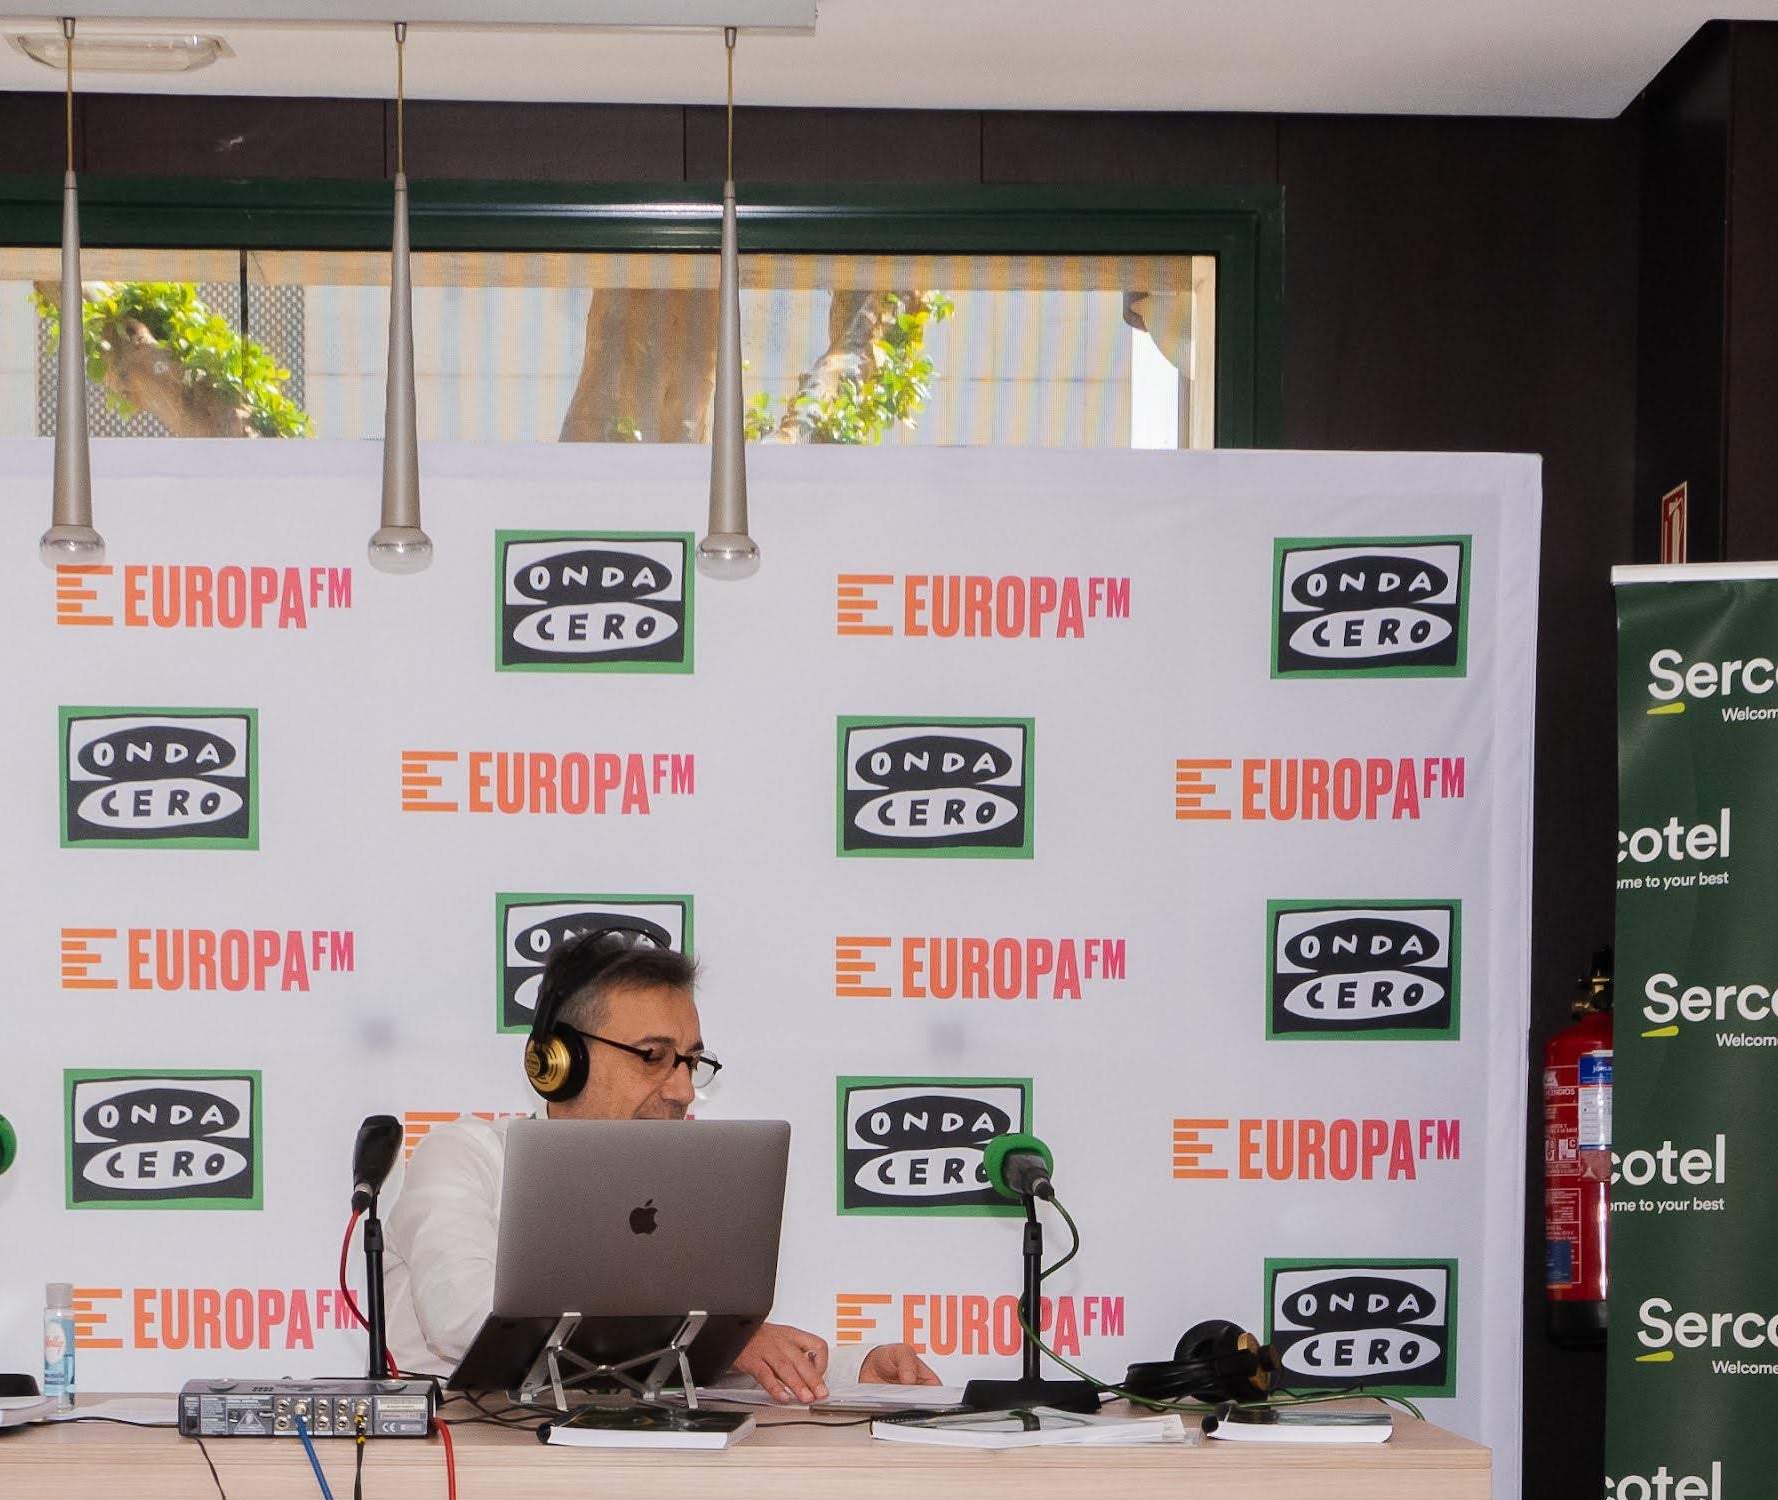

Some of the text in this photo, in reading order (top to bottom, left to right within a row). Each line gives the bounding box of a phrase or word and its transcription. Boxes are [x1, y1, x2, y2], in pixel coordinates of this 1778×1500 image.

[530, 566, 655, 590] ONDA
[1307, 572, 1431, 596] ONDA
[537, 614, 656, 640] CERO
[1313, 619, 1430, 647] CERO
[93, 742, 220, 766] ONDA
[871, 752, 996, 775] ONDA
[101, 790, 220, 817] CERO
[878, 799, 996, 826] CERO
[1645, 876, 1660, 887] to
[1663, 876, 1696, 890] your
[1699, 872, 1729, 885] best
[1300, 935, 1423, 958] ONDA
[1307, 981, 1423, 1009] CERO
[98, 1104, 224, 1128] ONDA
[871, 1112, 994, 1135] ONDA
[106, 1151, 225, 1178] CERO
[1639, 1199, 1654, 1211] to
[1657, 1201, 1690, 1214] your
[1694, 1197, 1724, 1210] best
[1298, 1293, 1419, 1316] ONDA
[1304, 1339, 1420, 1366] CERO
